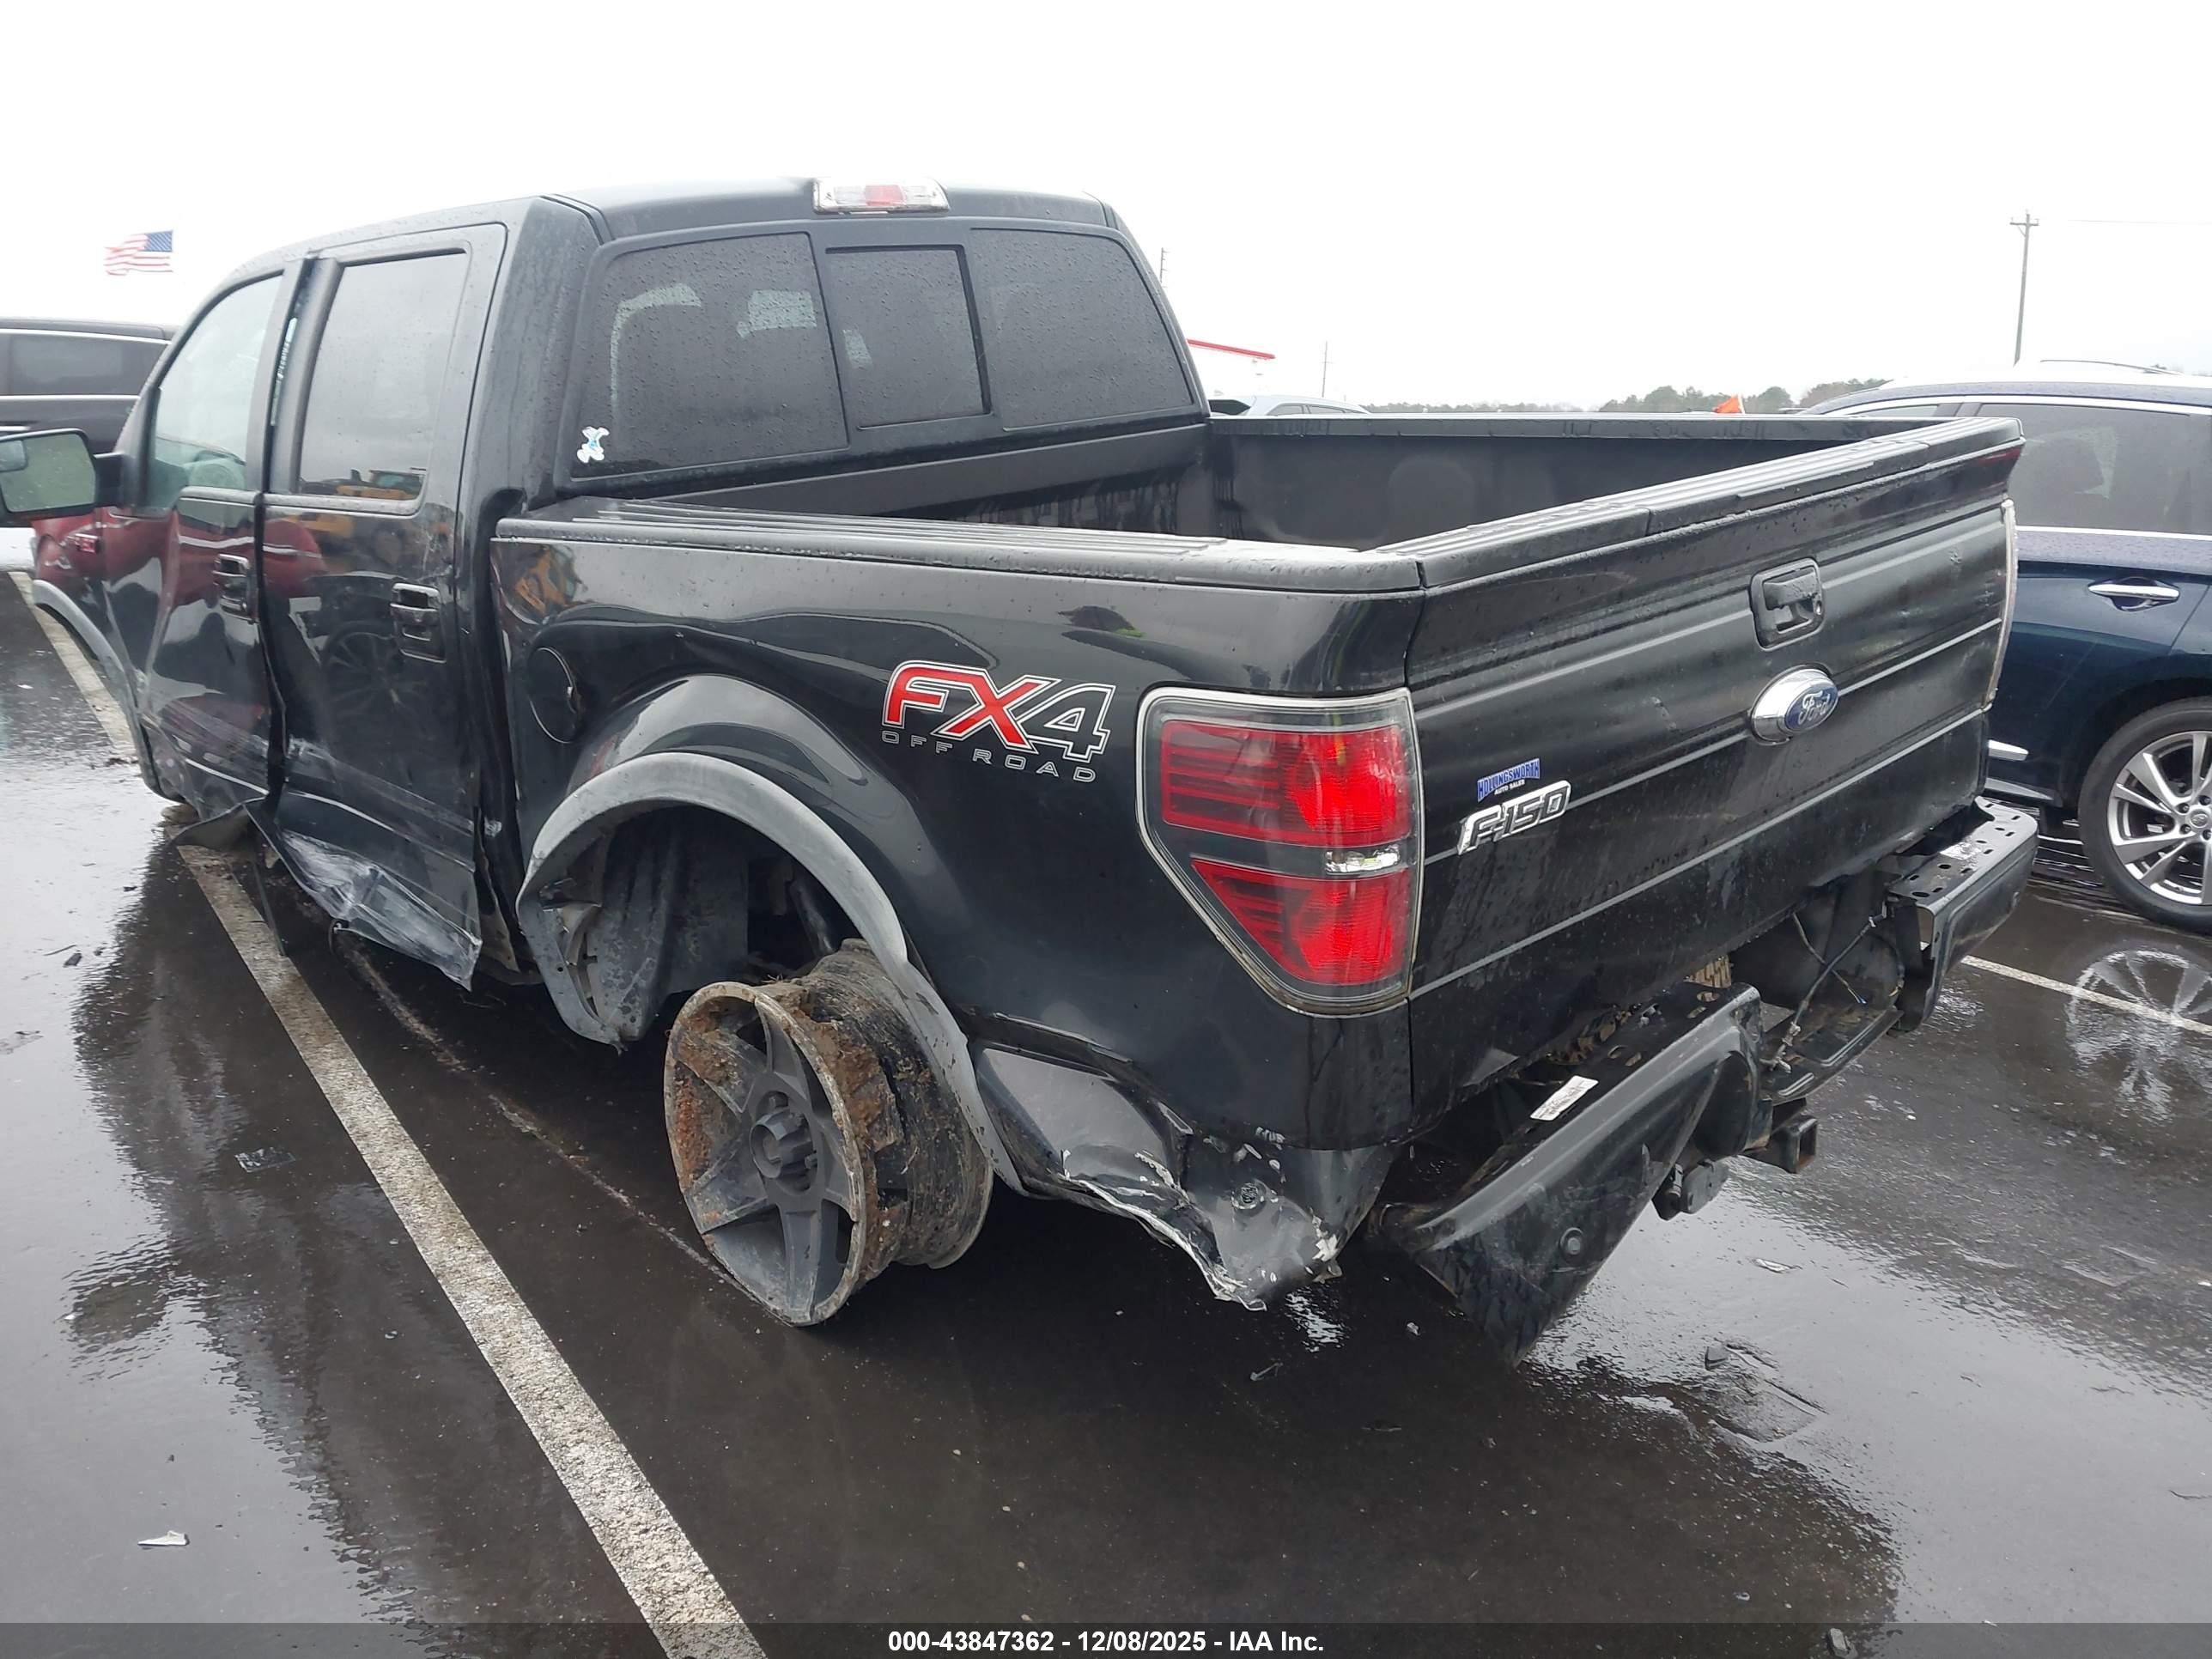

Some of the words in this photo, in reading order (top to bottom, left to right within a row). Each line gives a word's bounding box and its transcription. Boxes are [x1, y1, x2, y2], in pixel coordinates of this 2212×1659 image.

[882, 659, 1116, 763] FX4
[1798, 690, 1831, 725] Ford
[881, 730, 953, 754] OFF
[972, 748, 1097, 782] ROAD
[1477, 758, 1540, 802] HOLLINGSWORTH
[1494, 785, 1509, 795] AUTO
[1510, 779, 1526, 790] SALES
